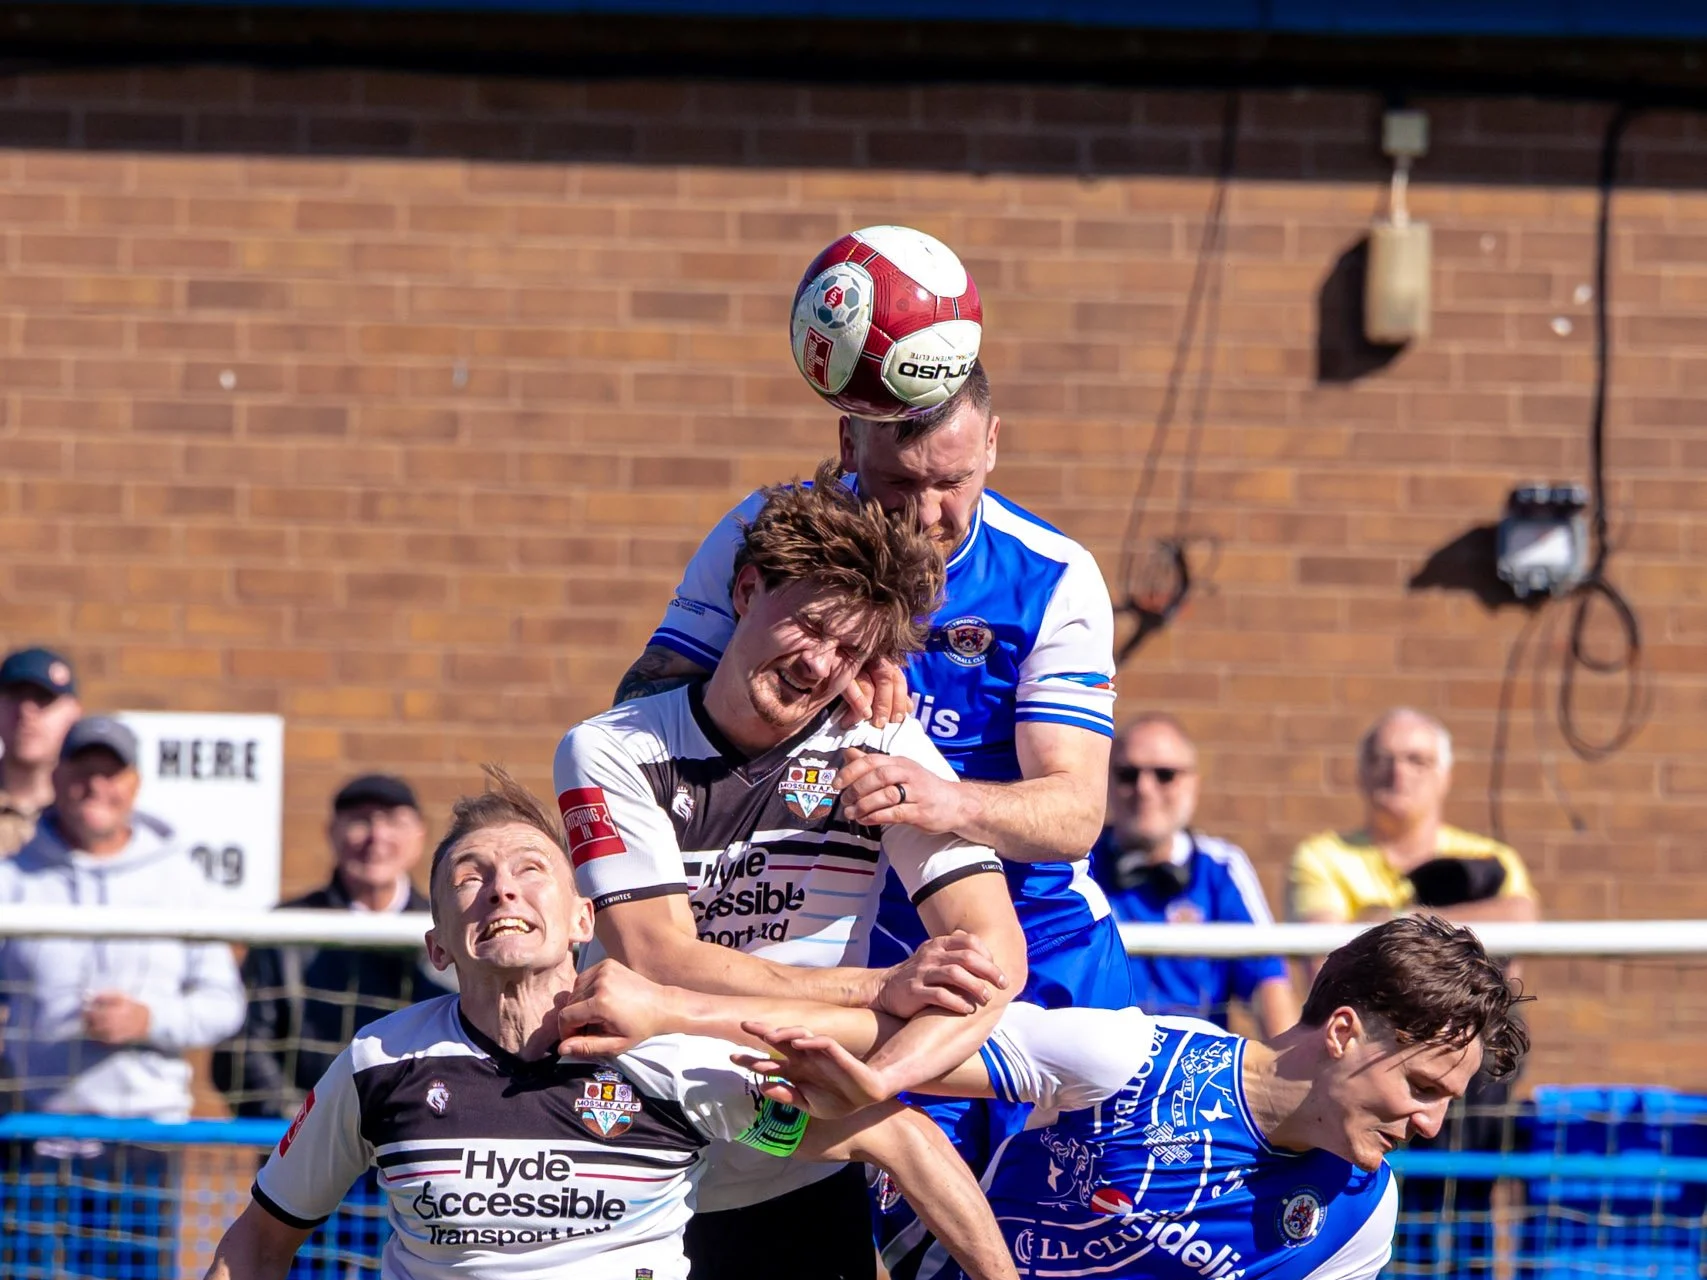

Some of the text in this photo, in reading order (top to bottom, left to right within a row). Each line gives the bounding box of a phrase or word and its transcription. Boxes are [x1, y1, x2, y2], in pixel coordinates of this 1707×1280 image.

[827, 287, 842, 307] NPL
[910, 351, 931, 361] ELITE
[158, 739, 259, 781] HERE
[780, 783, 817, 791] MOSSLEY
[580, 823, 593, 840] IN
[577, 1100, 614, 1109] MOSSLEY
[464, 1150, 571, 1188] Hyde
[424, 1224, 561, 1247] Transport
